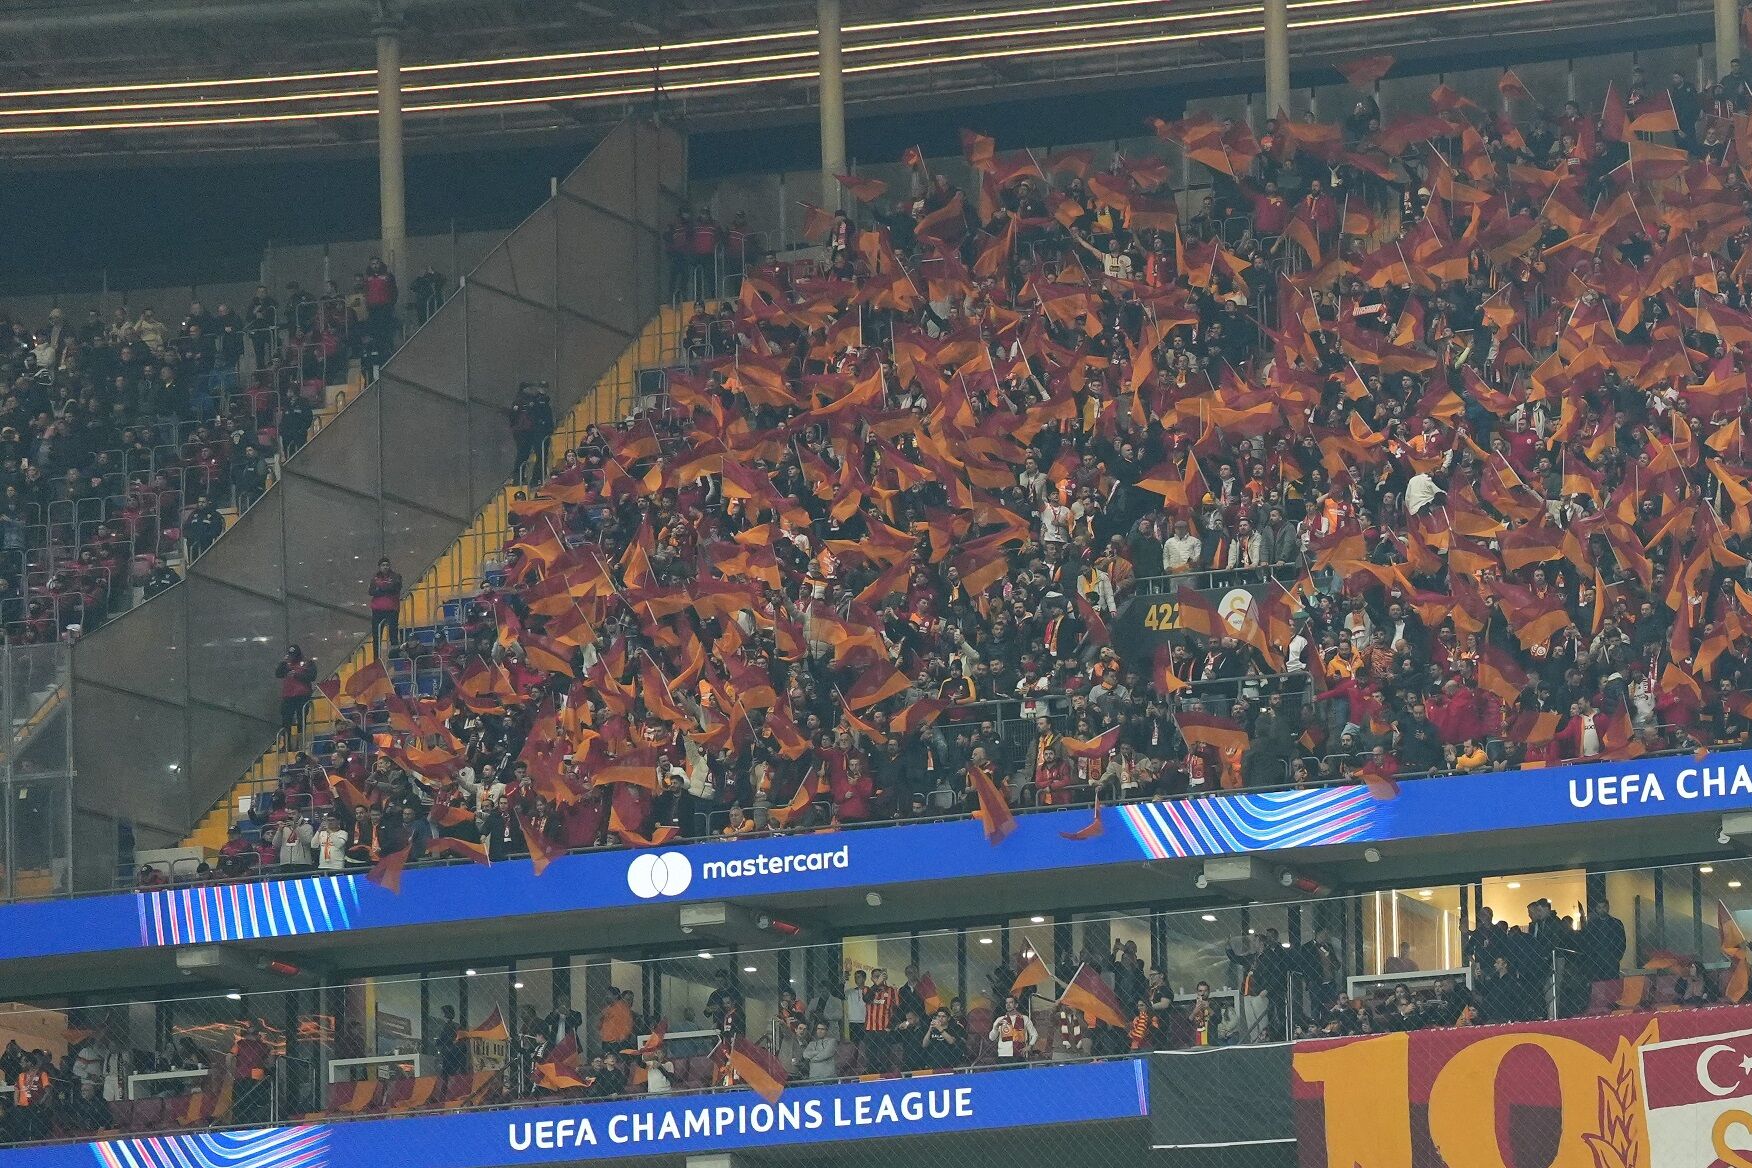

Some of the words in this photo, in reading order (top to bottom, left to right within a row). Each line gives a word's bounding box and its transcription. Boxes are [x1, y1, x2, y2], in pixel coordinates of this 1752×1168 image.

[1568, 773, 1665, 808] UEFA
[703, 845, 849, 879] mastercard
[508, 1118, 598, 1151] UEFA
[607, 1099, 823, 1143] CHAMPIONS
[834, 1087, 974, 1127] LEAGUE
